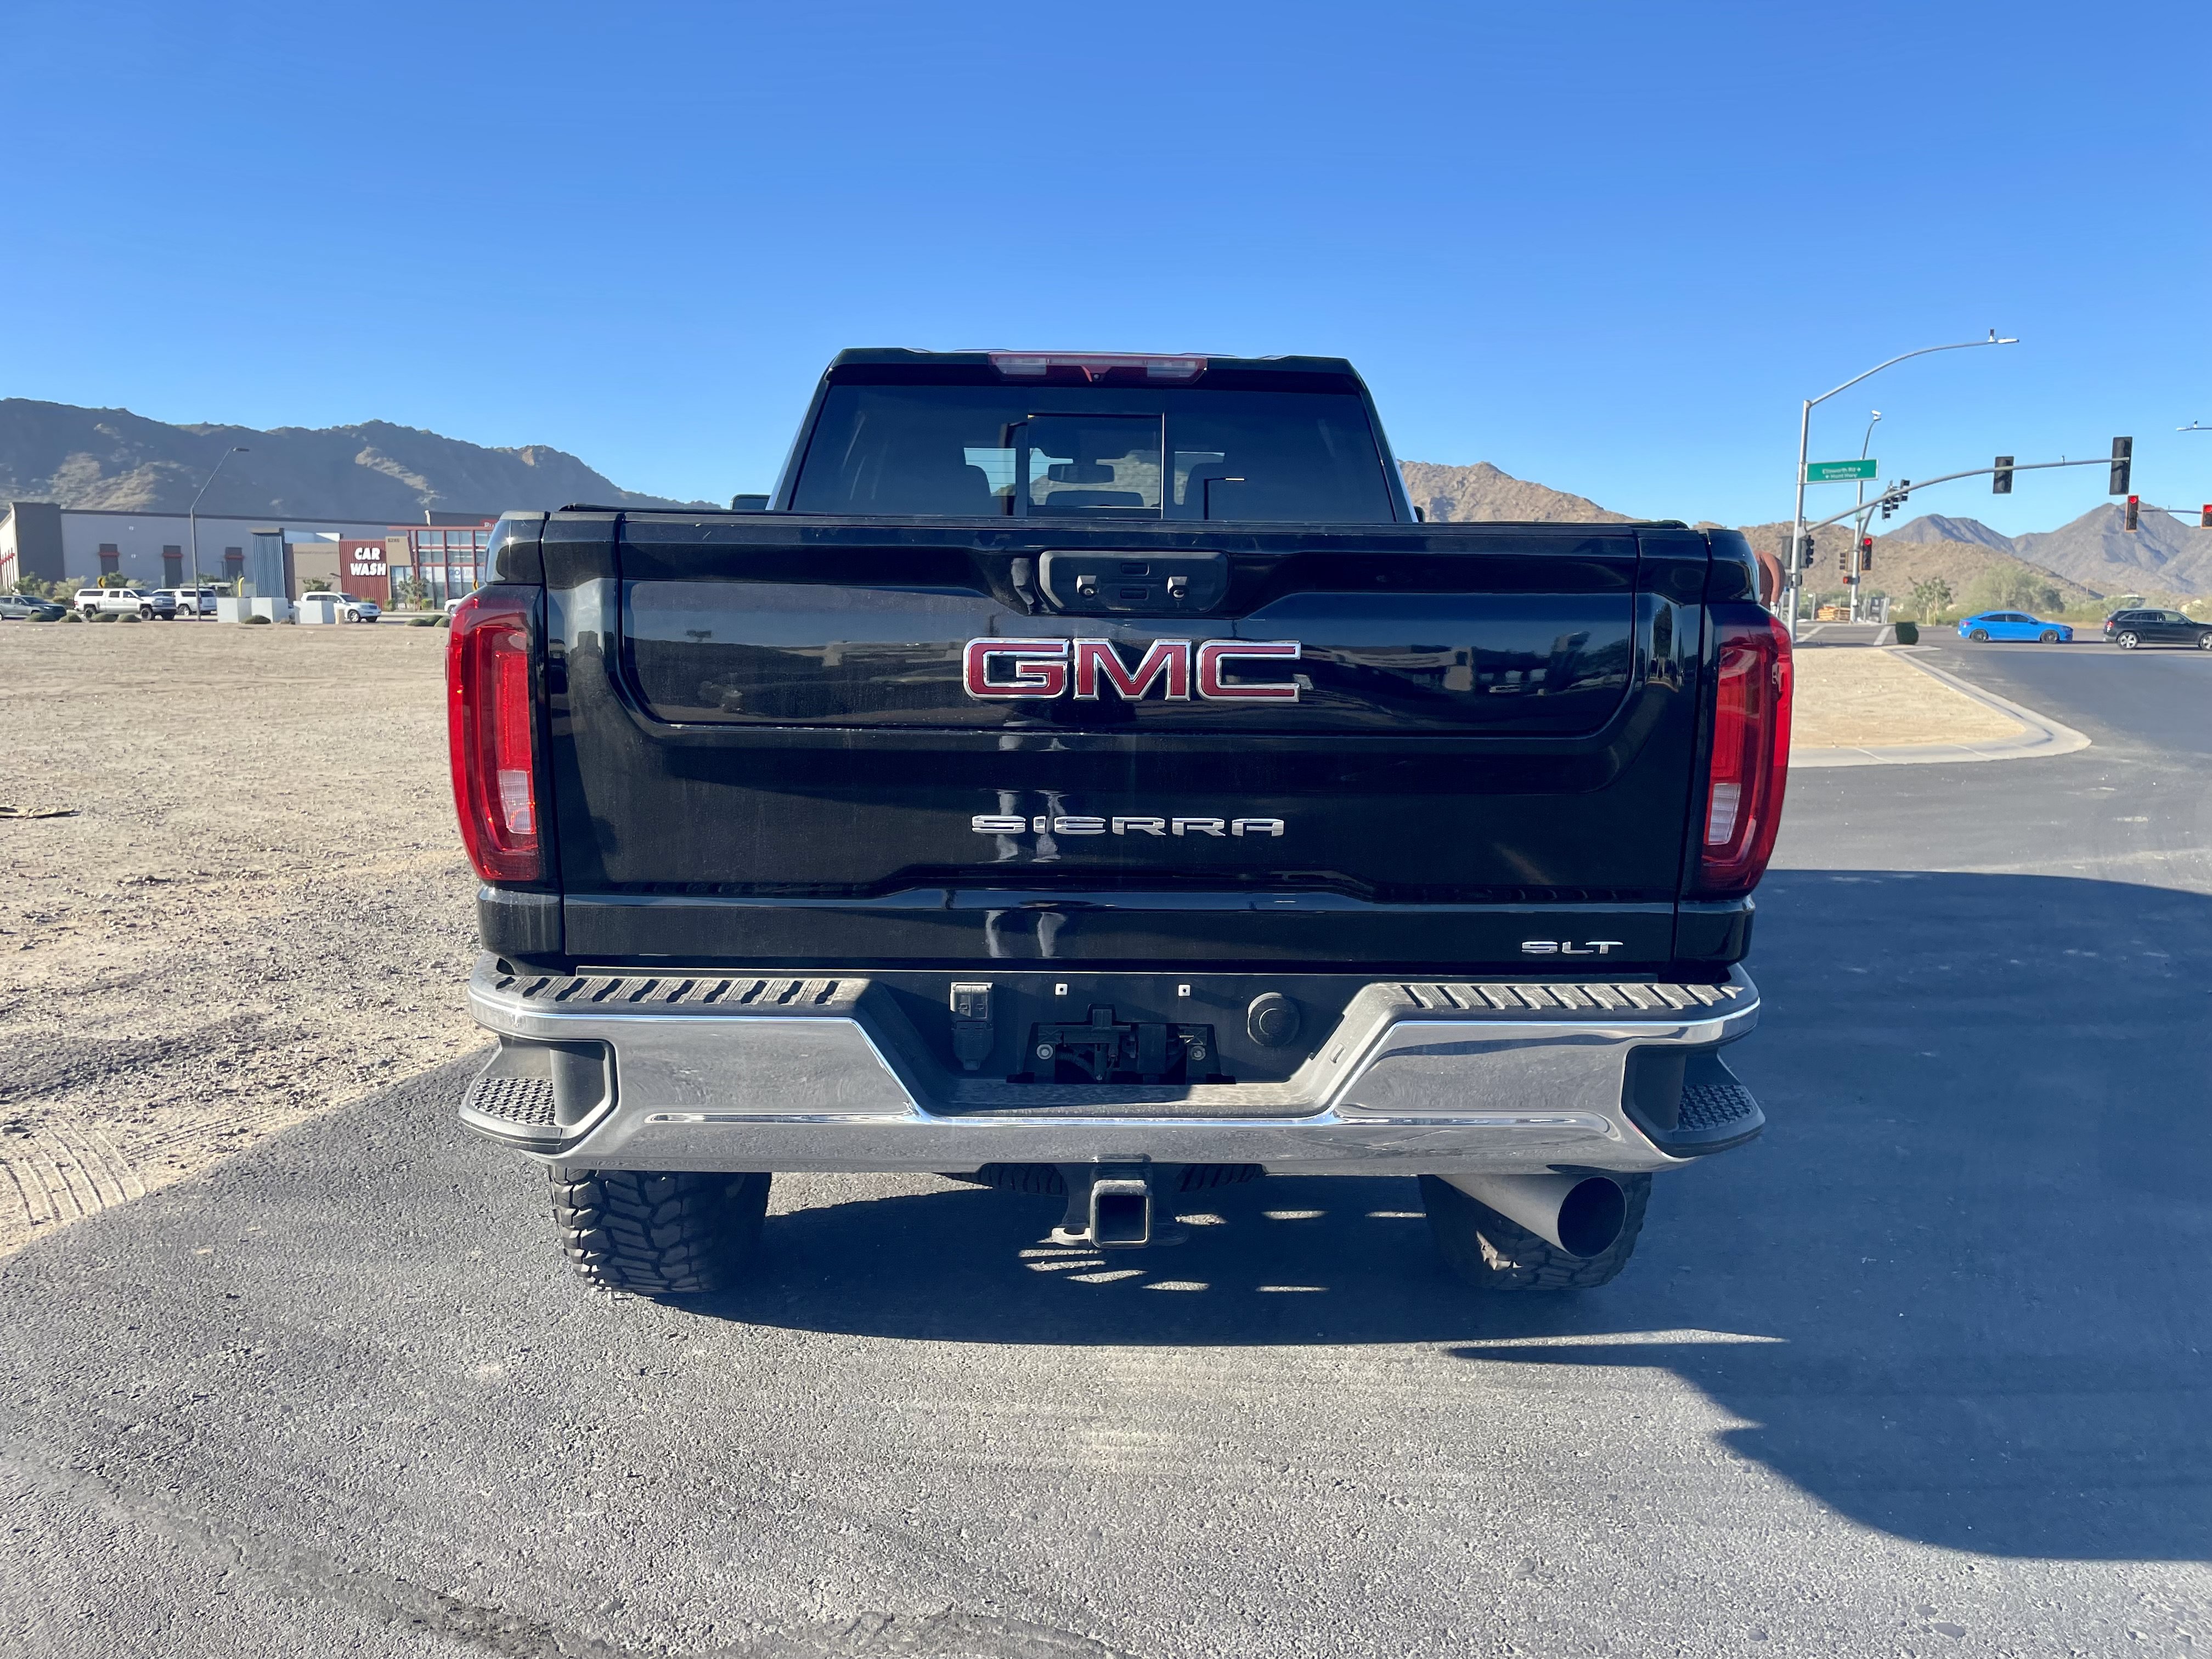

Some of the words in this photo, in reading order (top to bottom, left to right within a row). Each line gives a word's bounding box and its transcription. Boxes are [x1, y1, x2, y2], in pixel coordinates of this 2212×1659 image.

[354, 547, 381, 561] CAR
[350, 563, 387, 576] WASH
[963, 637, 1301, 702] GMC
[972, 815, 1285, 837] SIERRA
[1521, 941, 1623, 954] SLT
